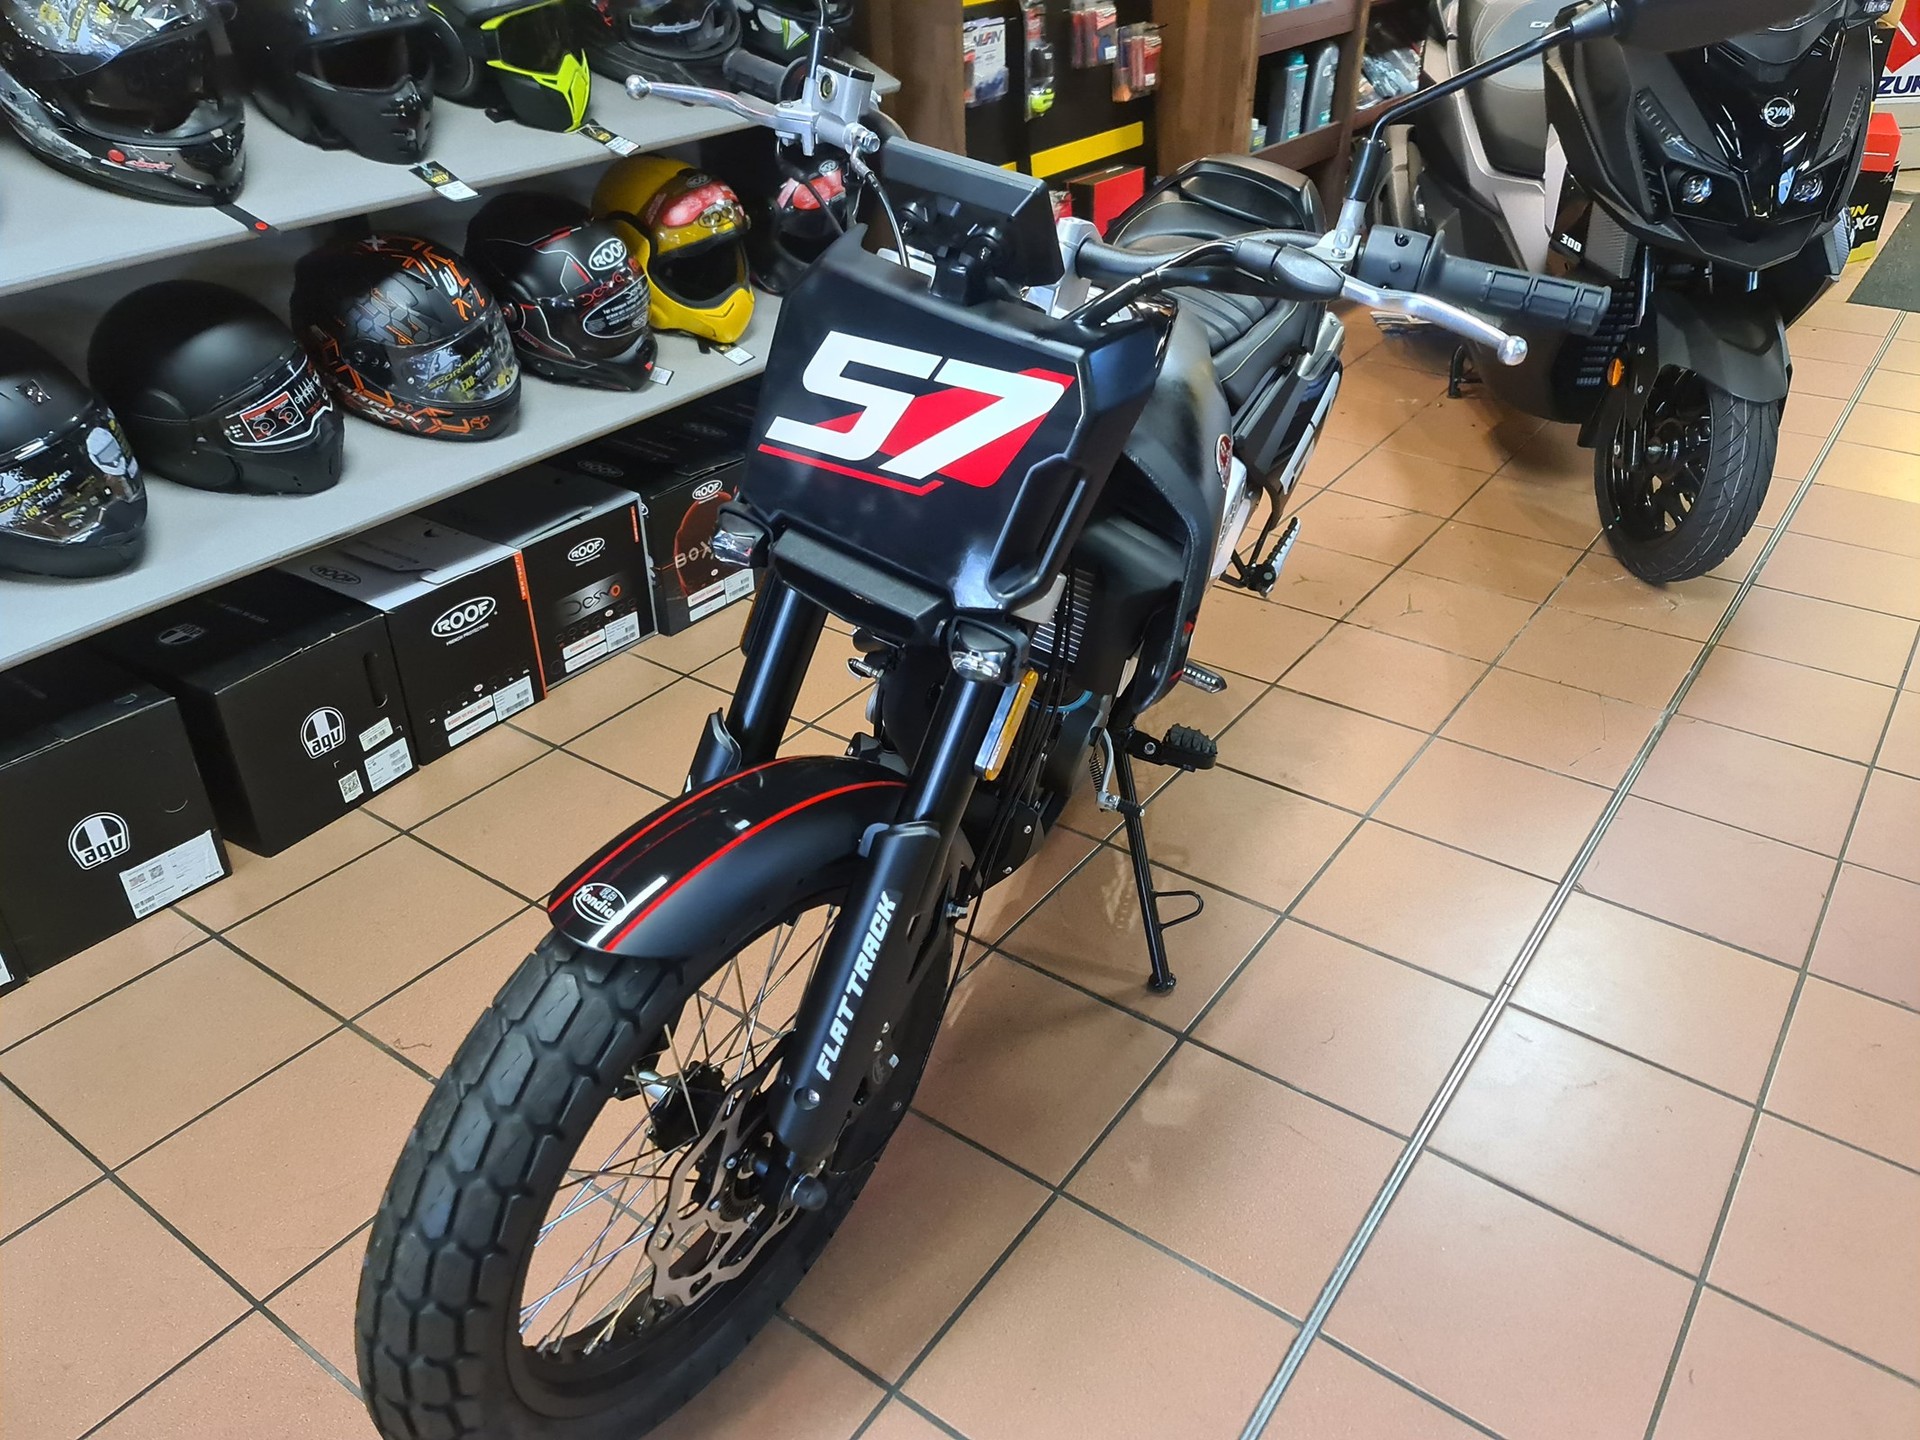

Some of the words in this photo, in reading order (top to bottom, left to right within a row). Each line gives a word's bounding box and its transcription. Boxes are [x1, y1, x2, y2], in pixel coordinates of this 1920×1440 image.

[1767, 106, 1790, 120] SYM
[592, 240, 624, 268] ROOF
[1560, 233, 1582, 253] 300
[427, 347, 484, 391] SCORPION
[694, 482, 720, 498] ROOF
[571, 540, 602, 559] ROOF
[437, 600, 489, 633] ROOF
[311, 727, 341, 756] agv
[84, 834, 123, 864] agv
[816, 995, 855, 1081] FLAT
[845, 890, 897, 998] TRACK
